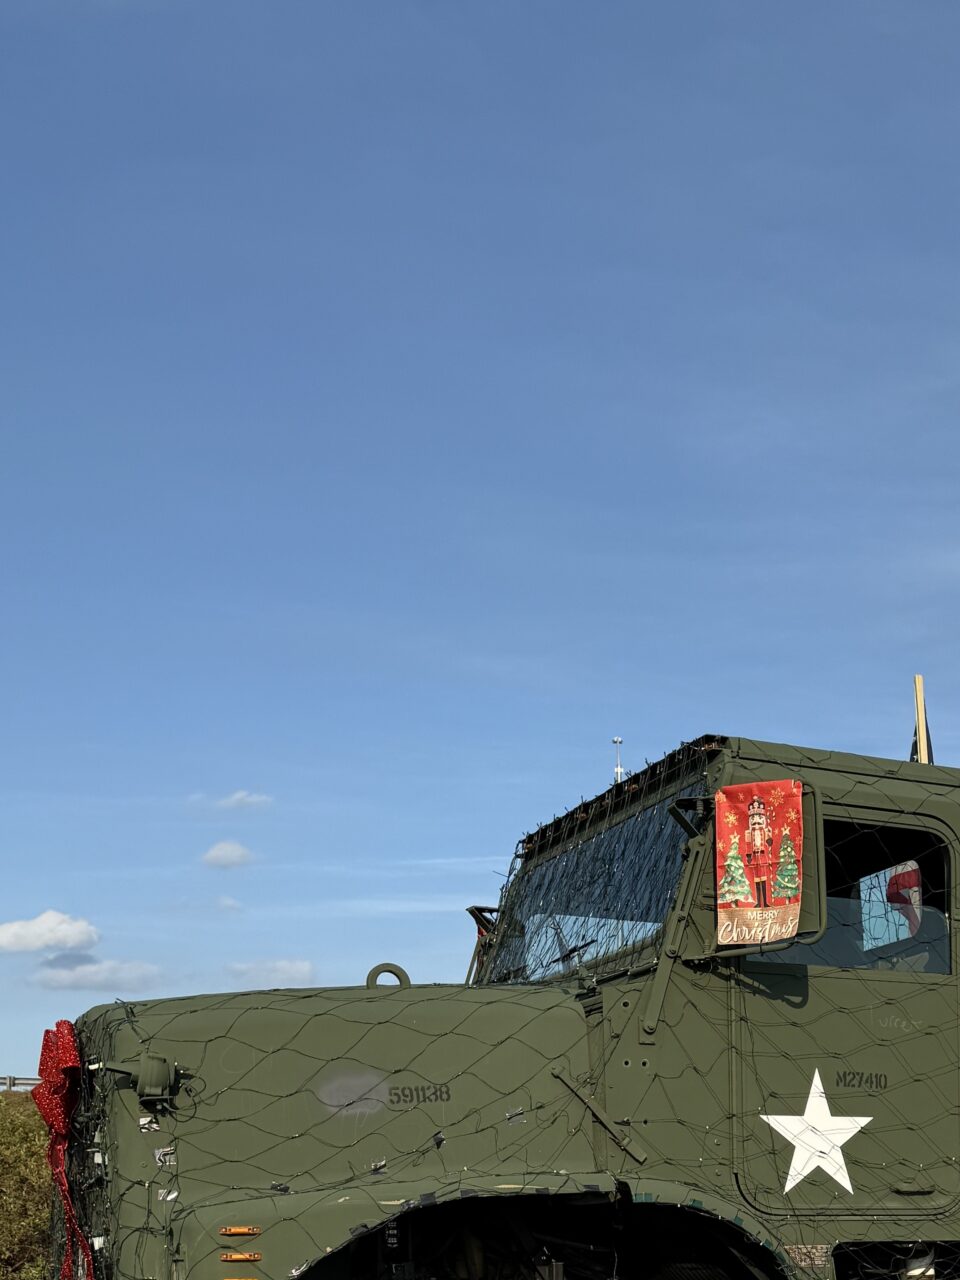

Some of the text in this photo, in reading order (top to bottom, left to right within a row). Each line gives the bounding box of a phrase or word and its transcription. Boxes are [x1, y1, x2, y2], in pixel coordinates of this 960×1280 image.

[747, 910, 779, 920] MERRY
[720, 917, 798, 942] Christmas
[836, 1071, 888, 1089] M27410
